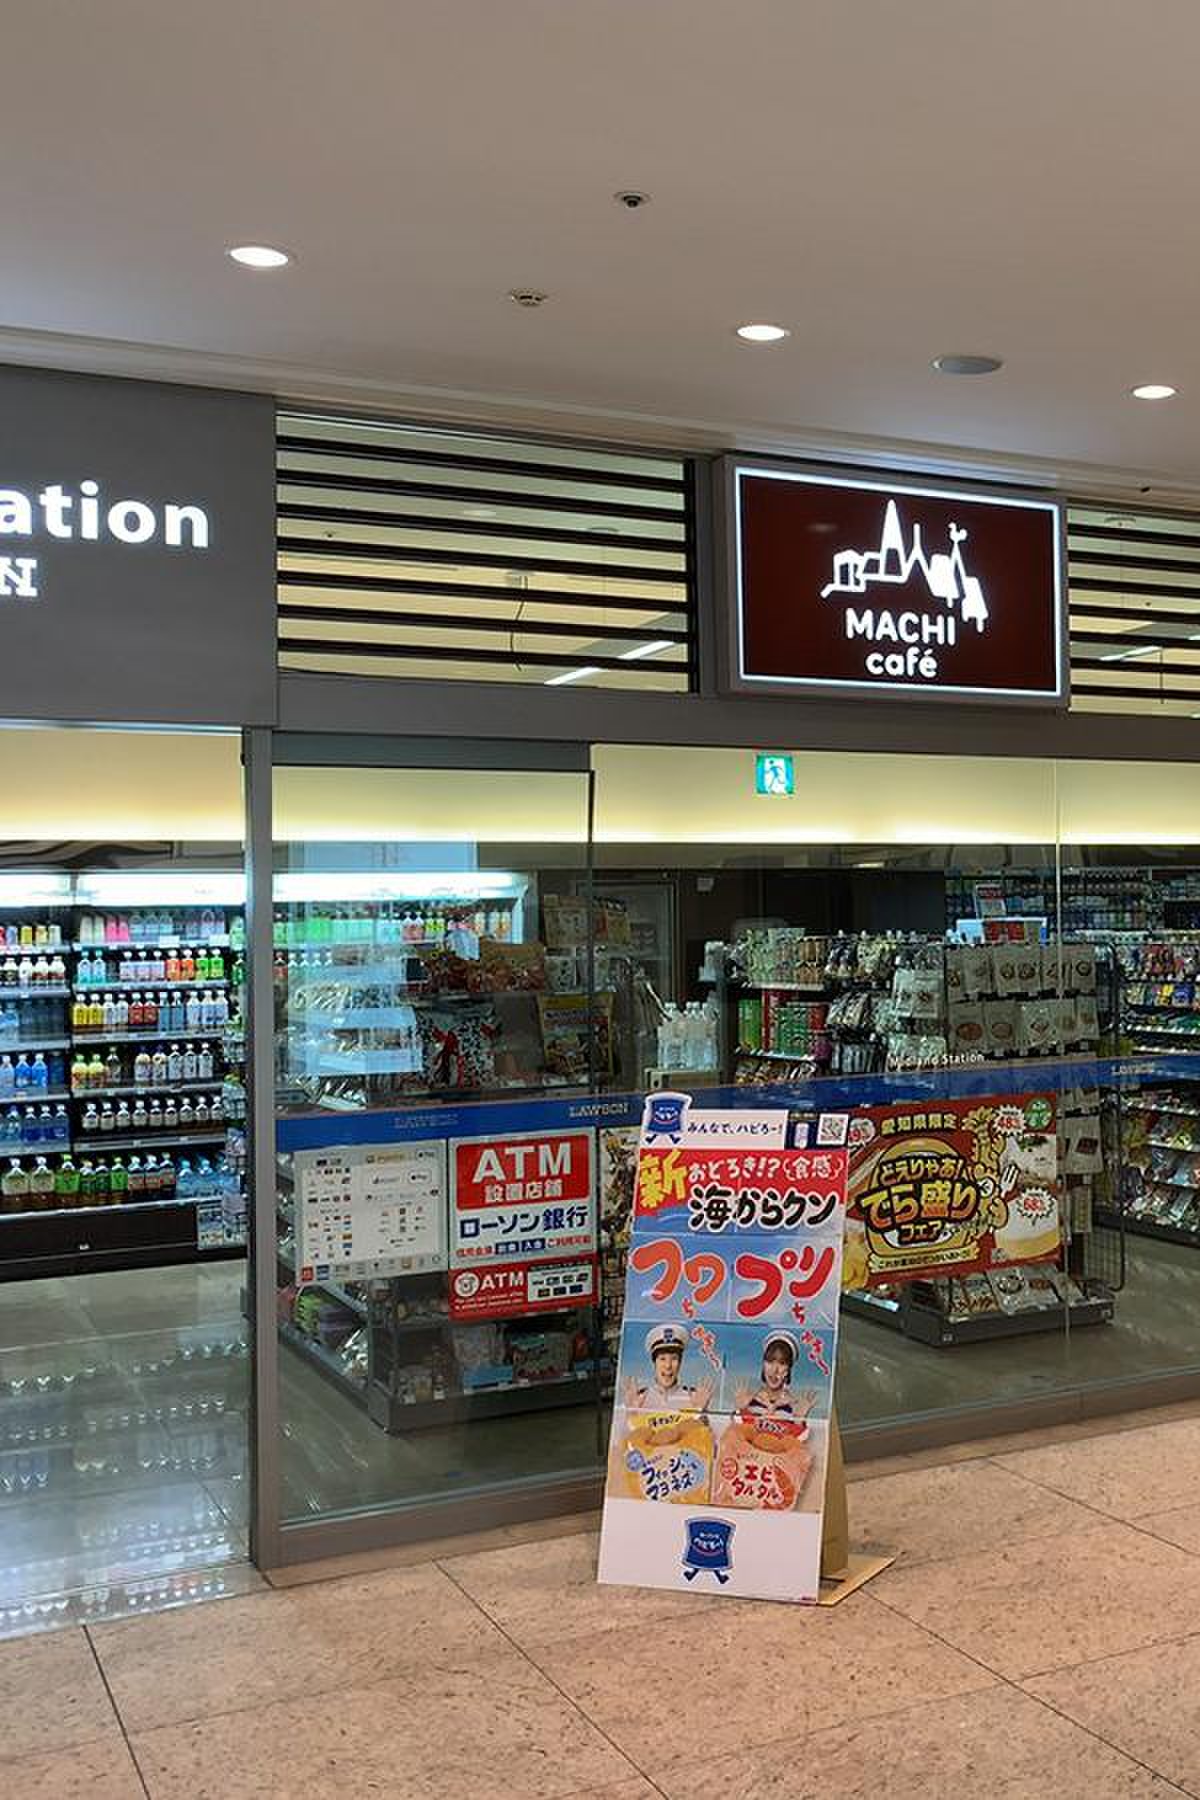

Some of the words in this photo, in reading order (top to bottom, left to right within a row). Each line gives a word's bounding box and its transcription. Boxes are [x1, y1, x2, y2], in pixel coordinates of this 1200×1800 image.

[0, 480, 208, 547] ation
[846, 608, 956, 645] MACHI
[865, 647, 938, 677] café
[941, 1049, 985, 1065] Station
[473, 1142, 571, 1183] ATM
[640, 1150, 688, 1208] 新
[485, 1178, 563, 1202] 設置店舗
[688, 1183, 839, 1231] 海からクン
[862, 1181, 977, 1230] でら盛り
[459, 1206, 589, 1239] ローソン銀行
[901, 1221, 942, 1241] フェア
[481, 1271, 524, 1290] ATM
